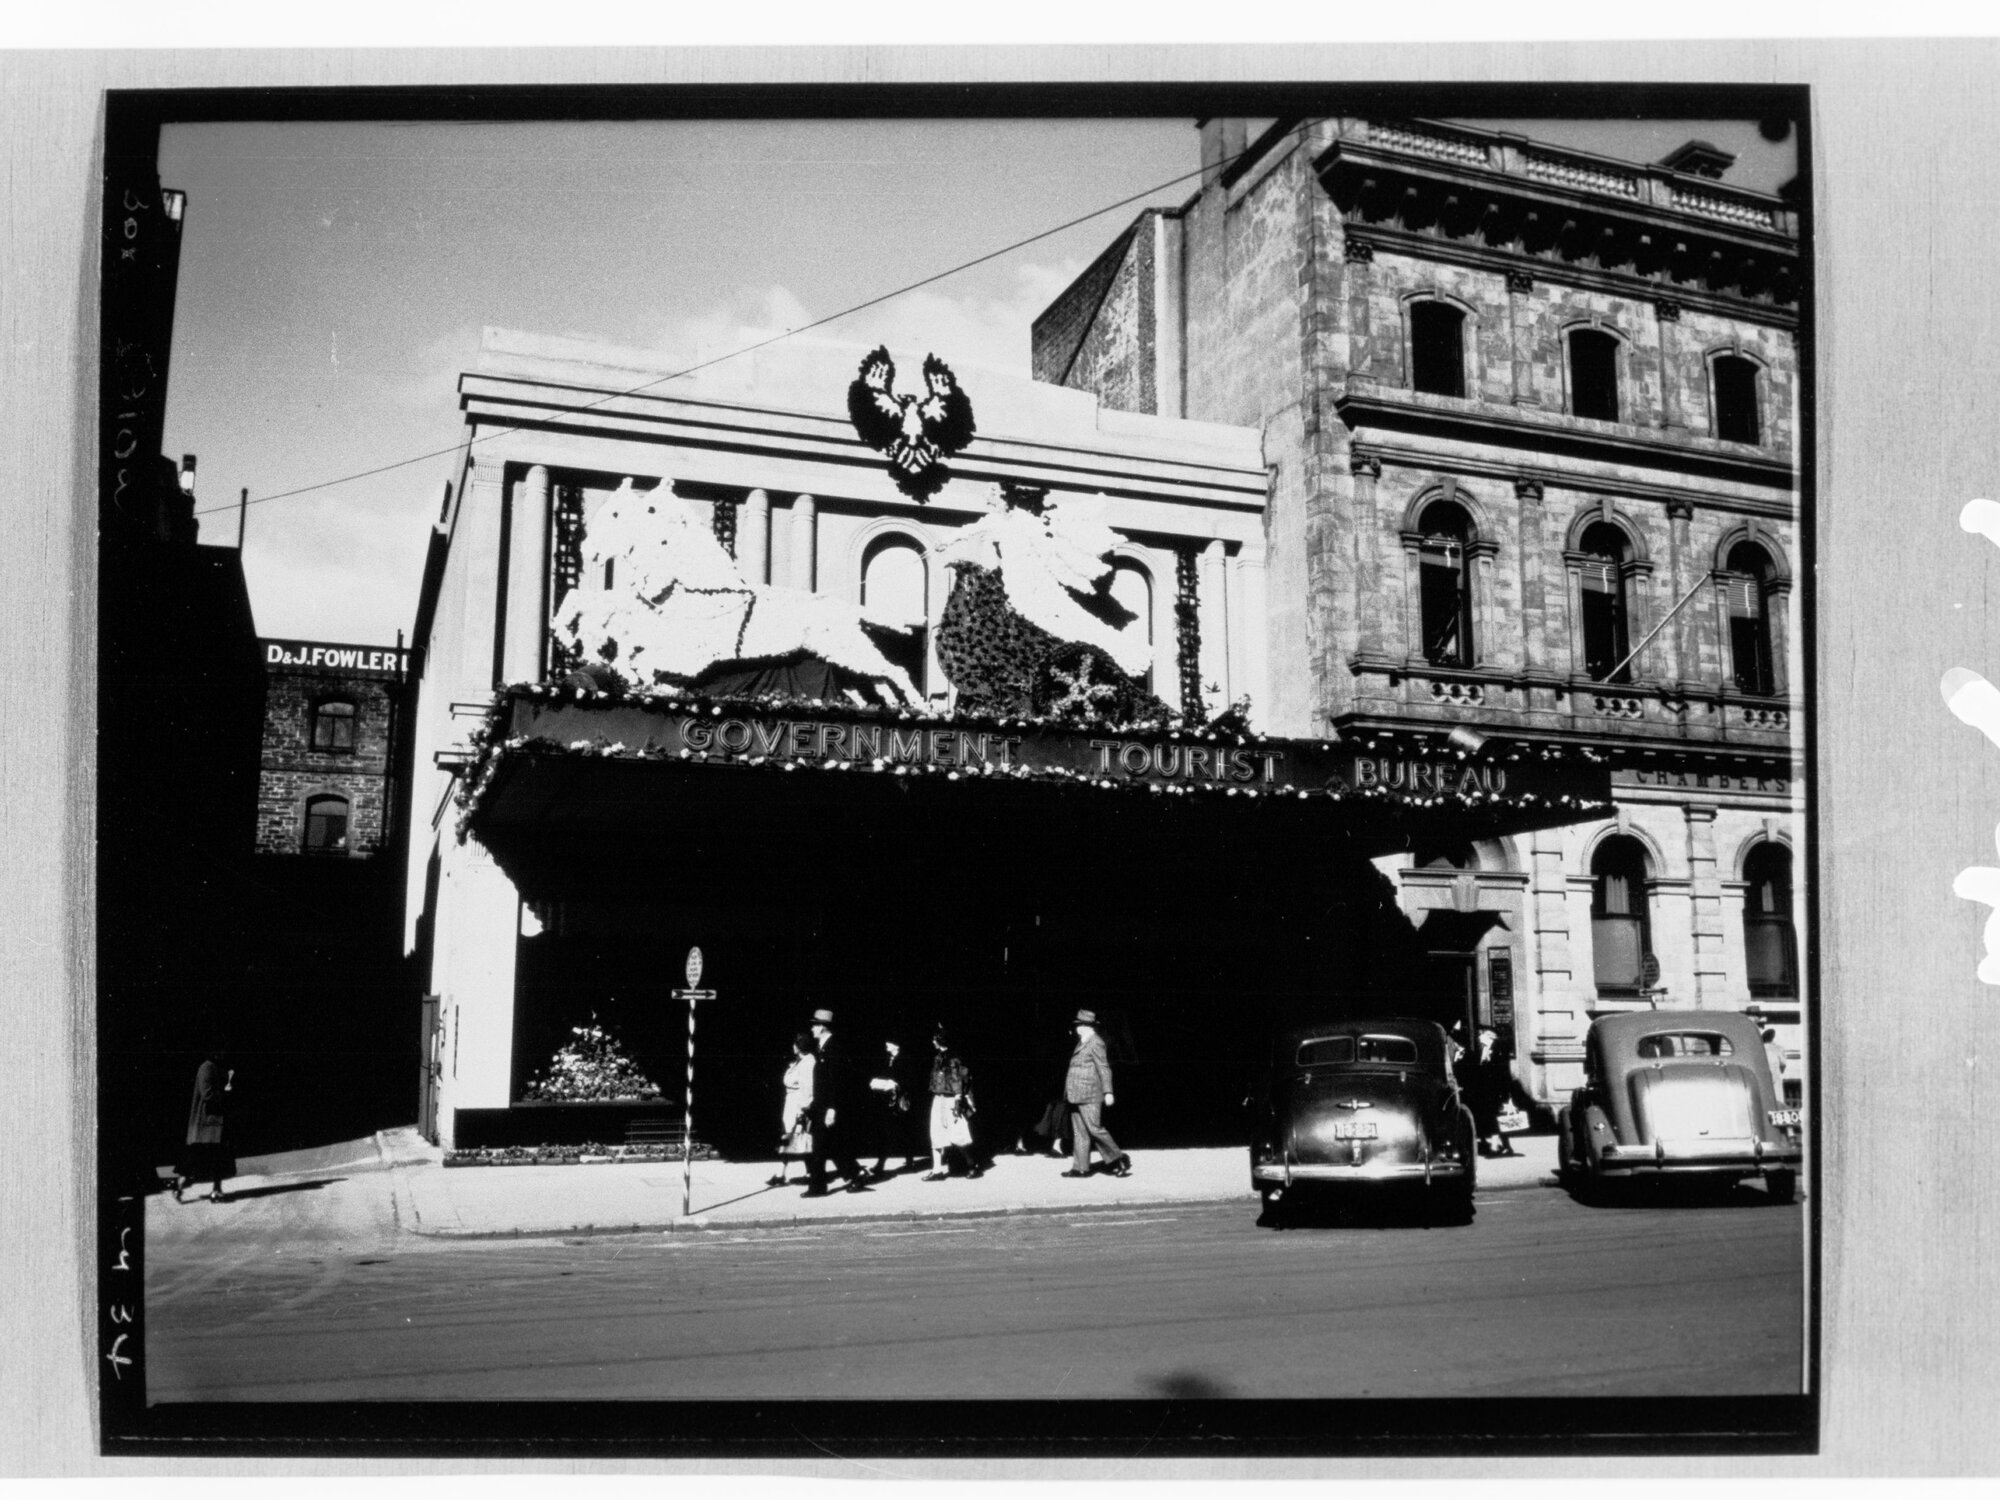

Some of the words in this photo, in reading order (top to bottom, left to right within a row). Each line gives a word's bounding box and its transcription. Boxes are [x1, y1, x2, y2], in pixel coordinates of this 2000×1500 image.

[679, 716, 1022, 765] GOVERNMENT
[1090, 738, 1285, 783] TOURIST
[1354, 756, 1507, 794] BUREAU
